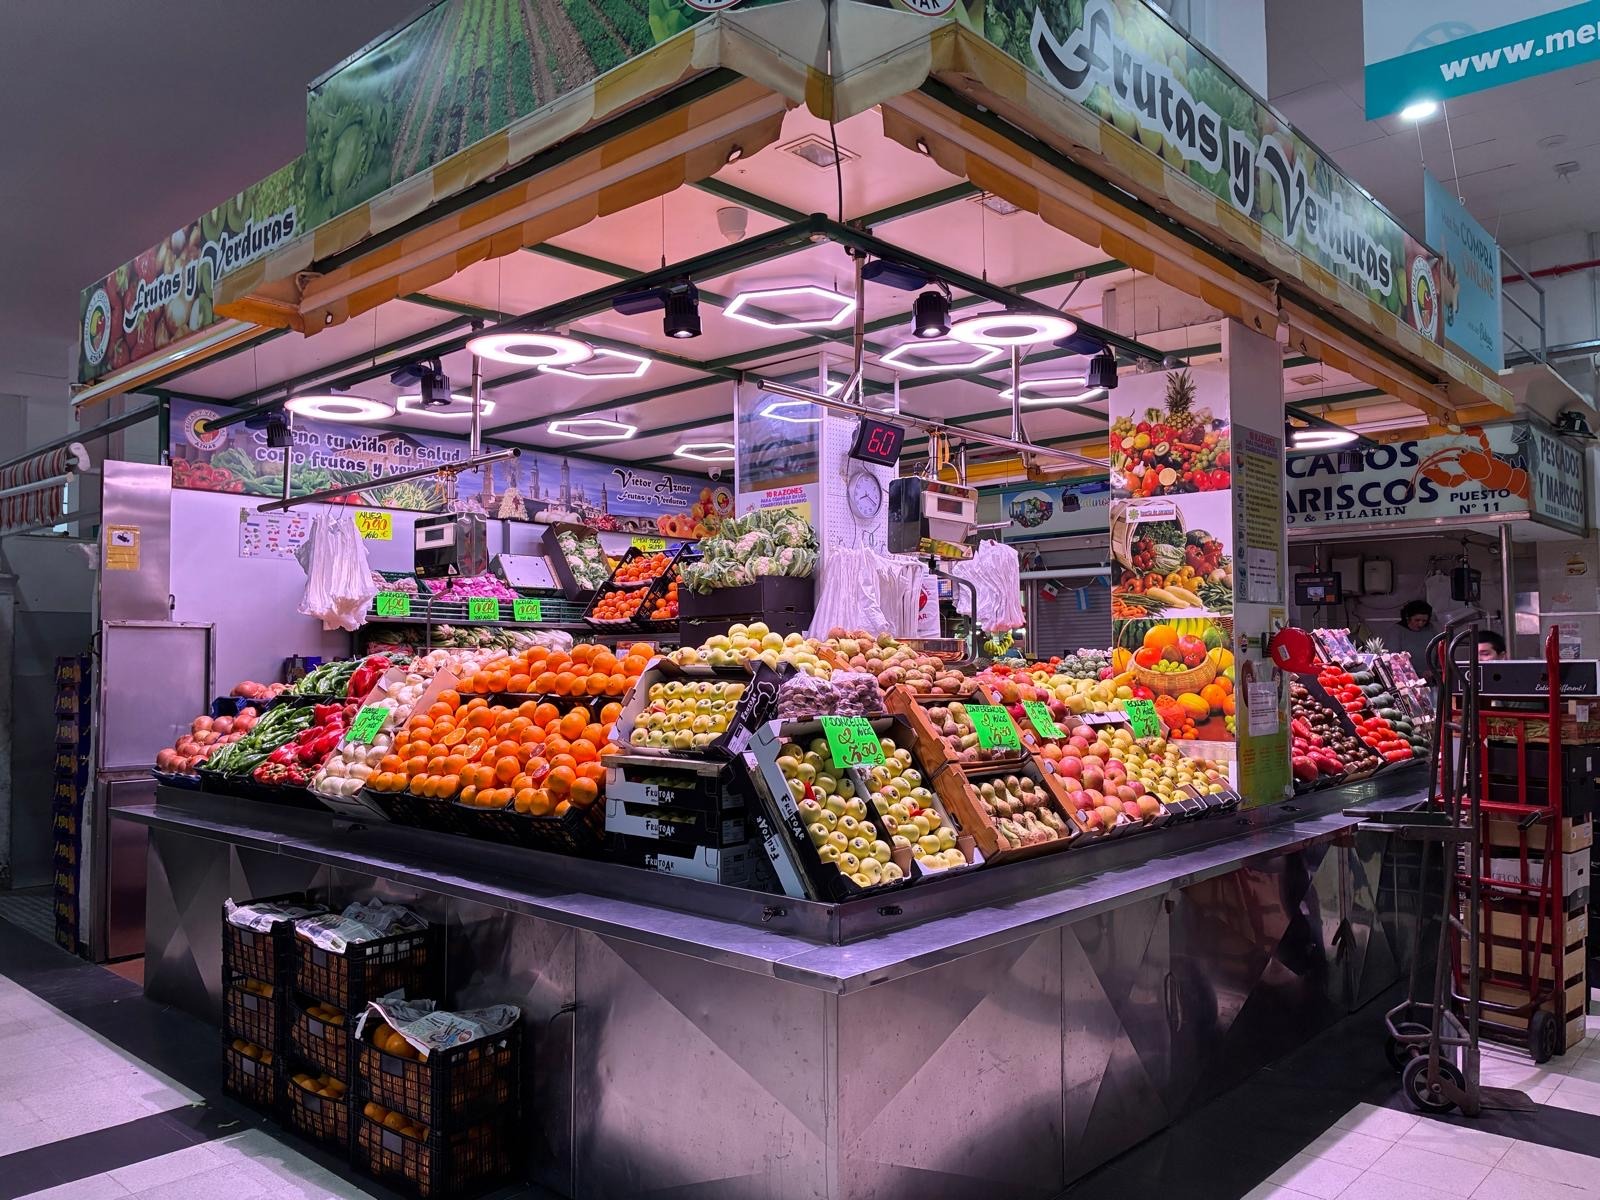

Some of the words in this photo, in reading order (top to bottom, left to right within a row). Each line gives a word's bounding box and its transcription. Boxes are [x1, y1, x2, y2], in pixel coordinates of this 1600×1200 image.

[1440, 21, 1600, 82] www.me
[1037, 9, 1218, 162] Frutas
[1233, 140, 1251, 207] y
[1264, 146, 1390, 288] Verduras
[1461, 222, 1493, 273] COMPRA
[124, 271, 182, 329] Frutas
[187, 265, 195, 297] y
[203, 212, 294, 281] Verduras
[1463, 253, 1494, 299] ONLINE
[326, 435, 343, 449] tu
[351, 436, 387, 453] vida
[394, 441, 411, 456] de
[417, 447, 460, 461] salud
[868, 428, 895, 456] 60
[312, 451, 366, 471] frutas
[373, 463, 382, 477] y
[1541, 436, 1579, 479] PESCADOS
[655, 476, 691, 493] Aznar
[773, 487, 803, 497] RAZONES
[1450, 488, 1510, 502] PUESTO
[1538, 472, 1544, 498] Y
[1547, 475, 1583, 514] MARISCOS
[654, 495, 686, 505] Verduras
[1304, 513, 1316, 522] &
[1325, 506, 1406, 521] PILARIN
[1483, 502, 1499, 513] 11
[838, 728, 855, 744] 2
[781, 793, 804, 841] FRUTOAR
[756, 816, 779, 861] FRUTOAR
